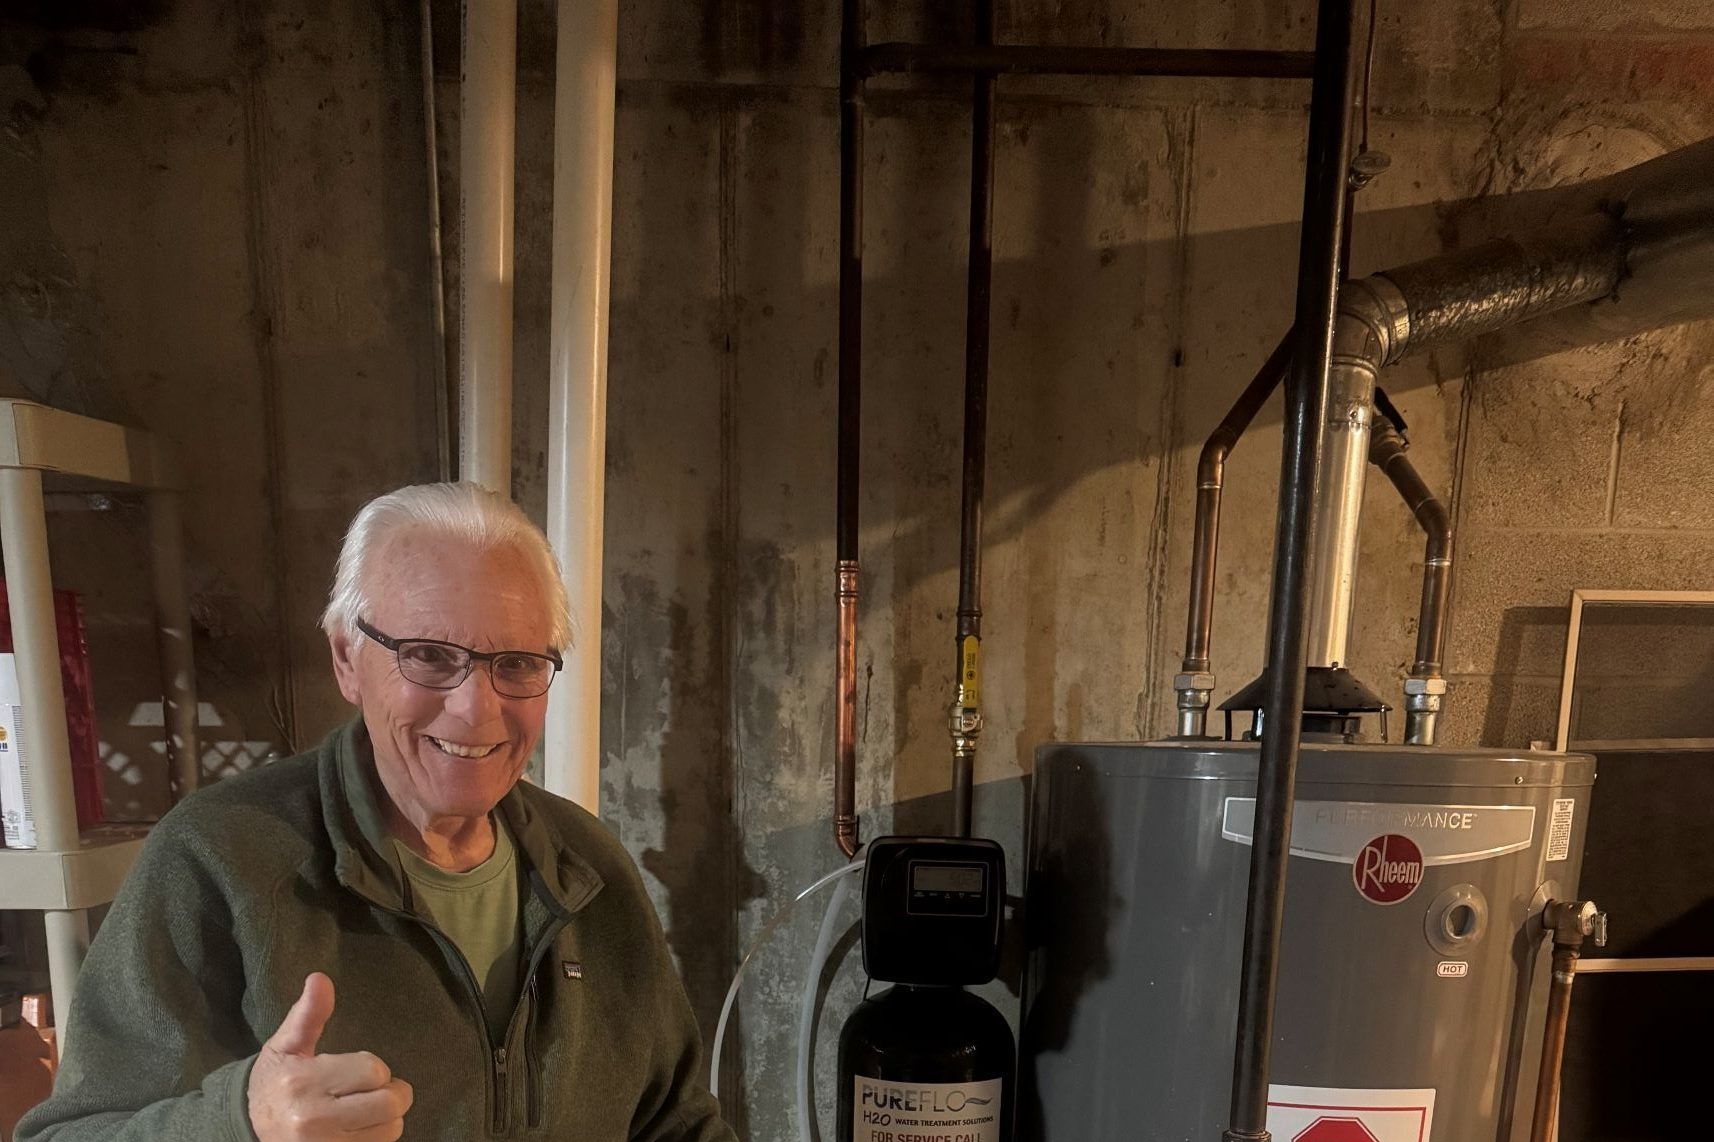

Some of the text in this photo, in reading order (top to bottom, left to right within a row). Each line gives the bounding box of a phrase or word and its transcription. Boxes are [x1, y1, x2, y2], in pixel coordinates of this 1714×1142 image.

[1361, 836, 1419, 892] Rheem
[862, 1084, 966, 1112] PUREFLO
[863, 1110, 994, 1127] H2O WATER TREATMENT SOLUTIONS
